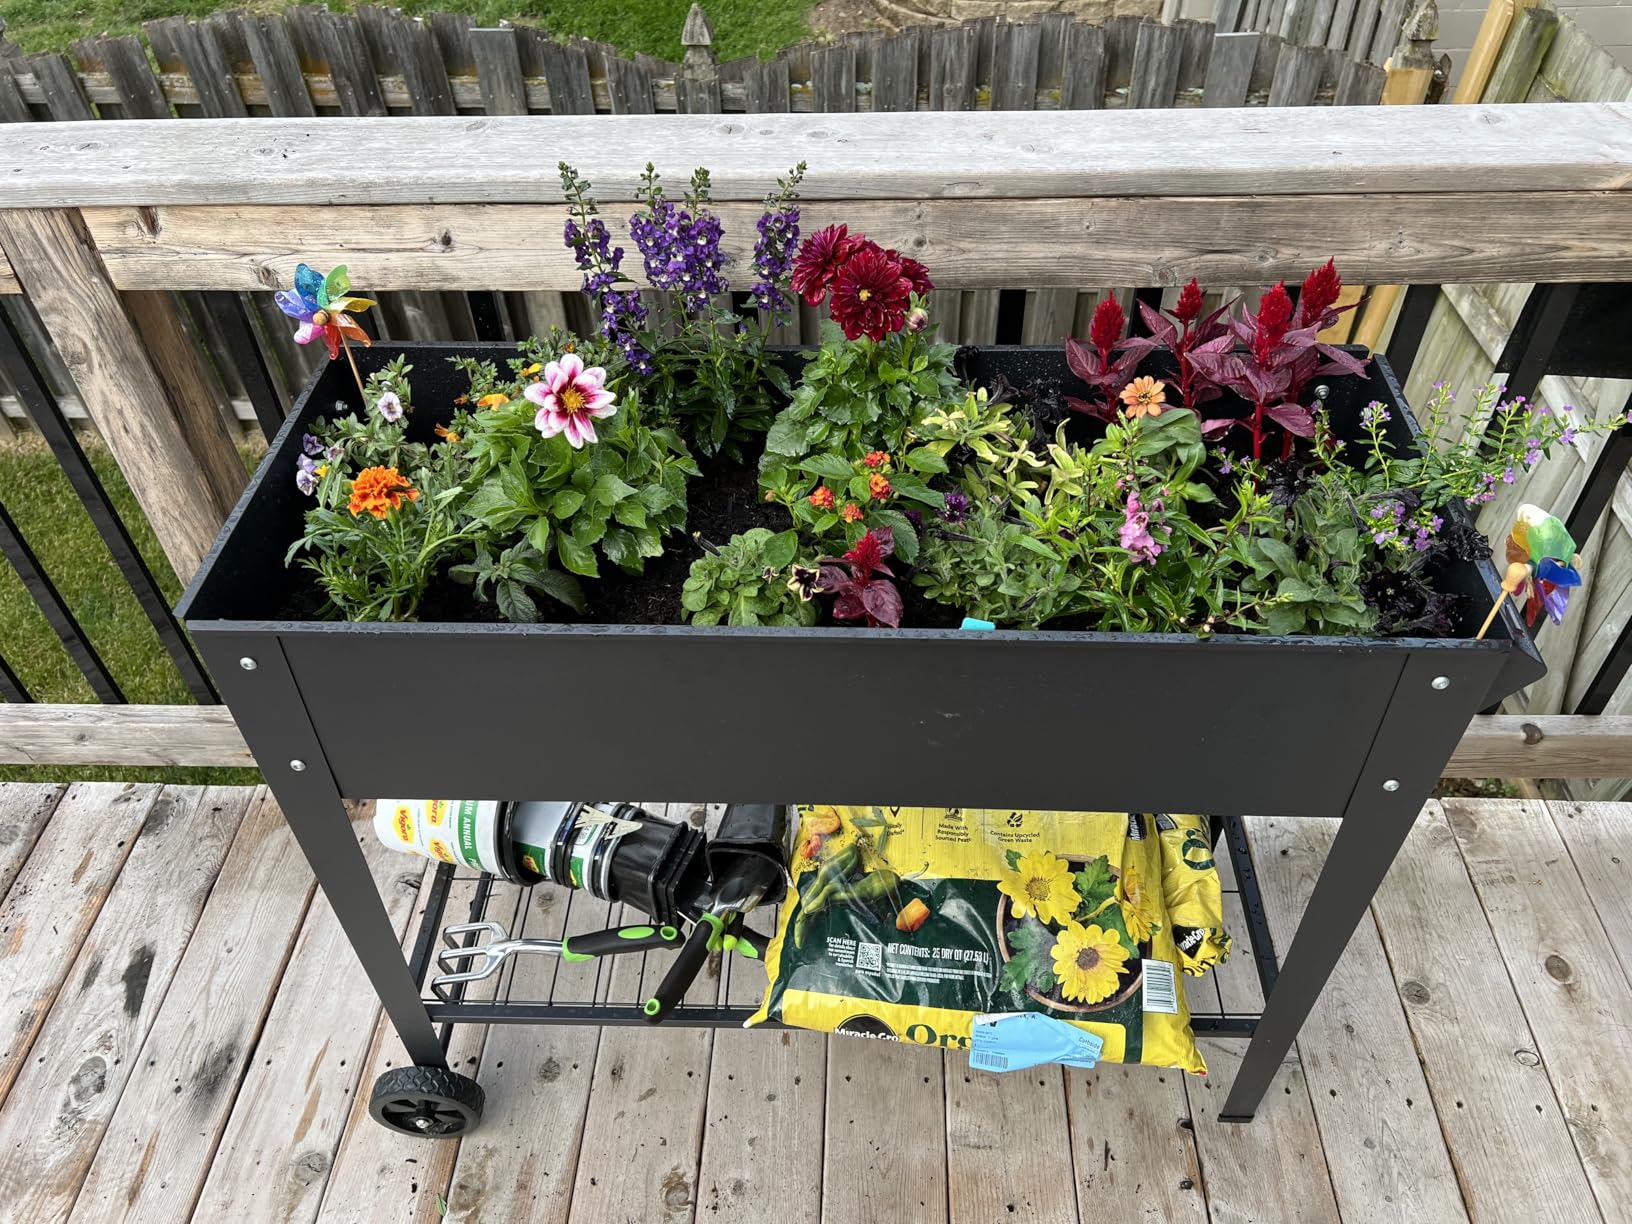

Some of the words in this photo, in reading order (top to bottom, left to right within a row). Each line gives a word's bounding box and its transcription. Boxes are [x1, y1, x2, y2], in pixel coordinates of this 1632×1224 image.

[399, 809, 409, 841] Vigora
[939, 823, 954, 831] Made
[955, 824, 969, 832] With
[463, 817, 473, 850] ANNUAL
[937, 829, 969, 838] Responsibly
[990, 830, 1014, 838] Contains
[1014, 831, 1041, 839] Upcycled
[826, 936, 842, 944] SCAN
[842, 938, 857, 947] HERE
[887, 942, 899, 954] NET
[899, 943, 931, 958] CONTENTS:
[932, 947, 941, 959] 25
[941, 948, 954, 960] DRY
[954, 949, 963, 961] QT
[963, 950, 983, 963] (27.53
